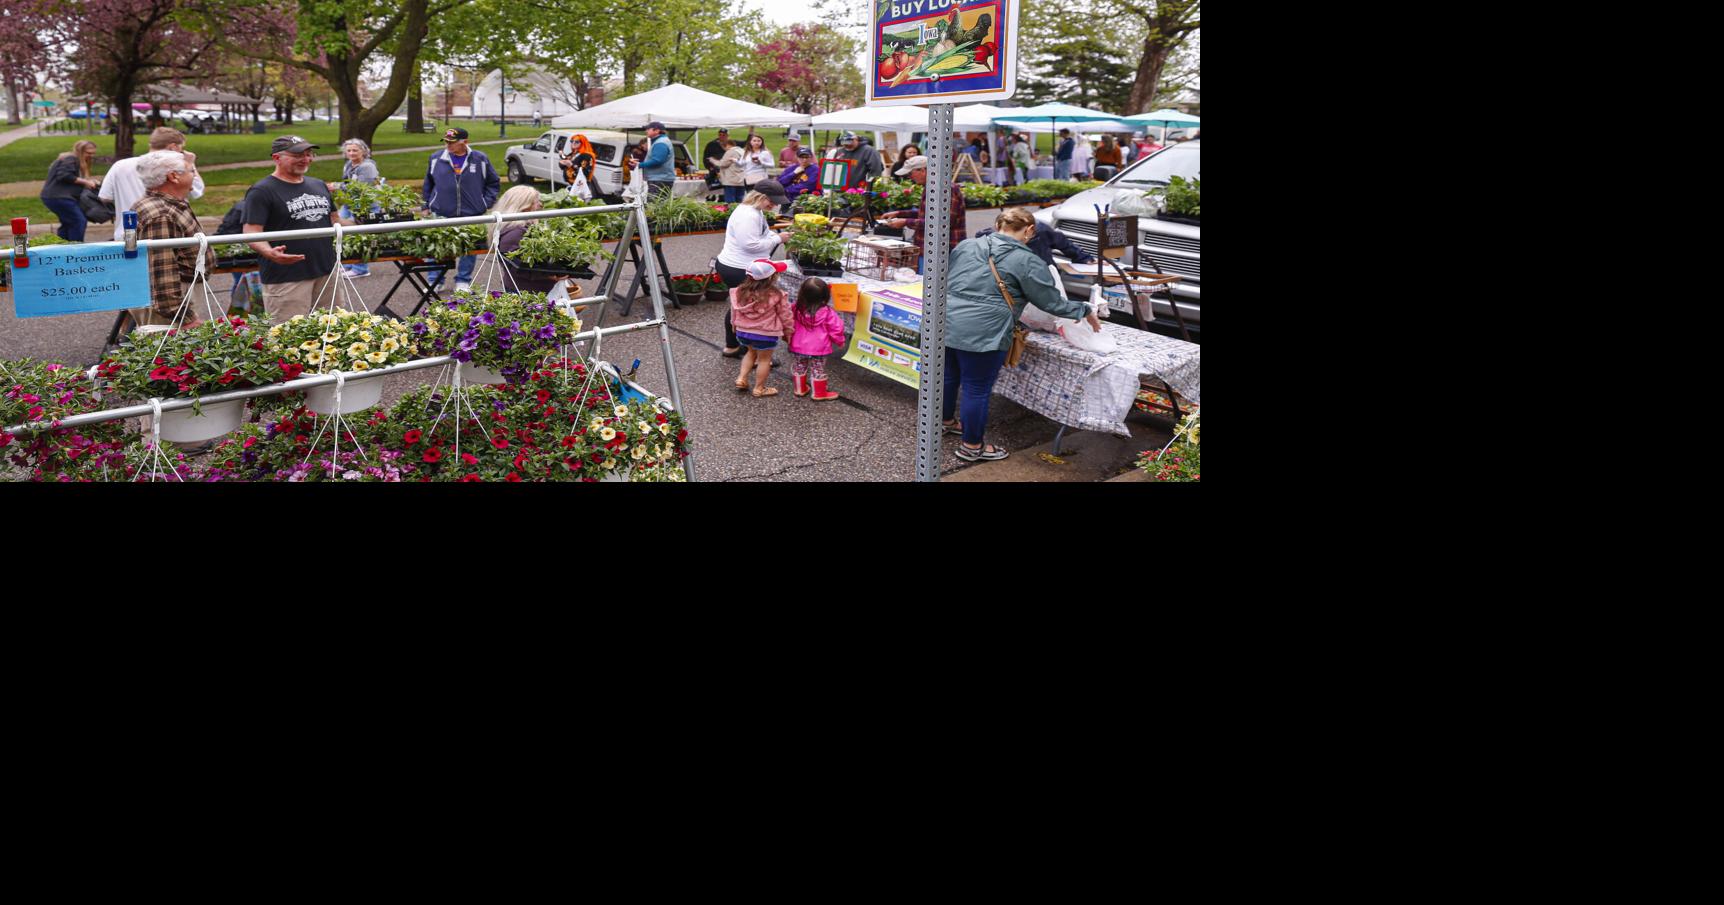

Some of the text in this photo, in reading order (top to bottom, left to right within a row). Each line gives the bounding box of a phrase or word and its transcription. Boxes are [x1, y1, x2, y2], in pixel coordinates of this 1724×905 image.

[891, 0, 926, 17] BUY
[66, 253, 125, 264] Premium
[54, 265, 105, 277] Baskets
[41, 285, 87, 297] $25.00
[91, 282, 120, 293] each
